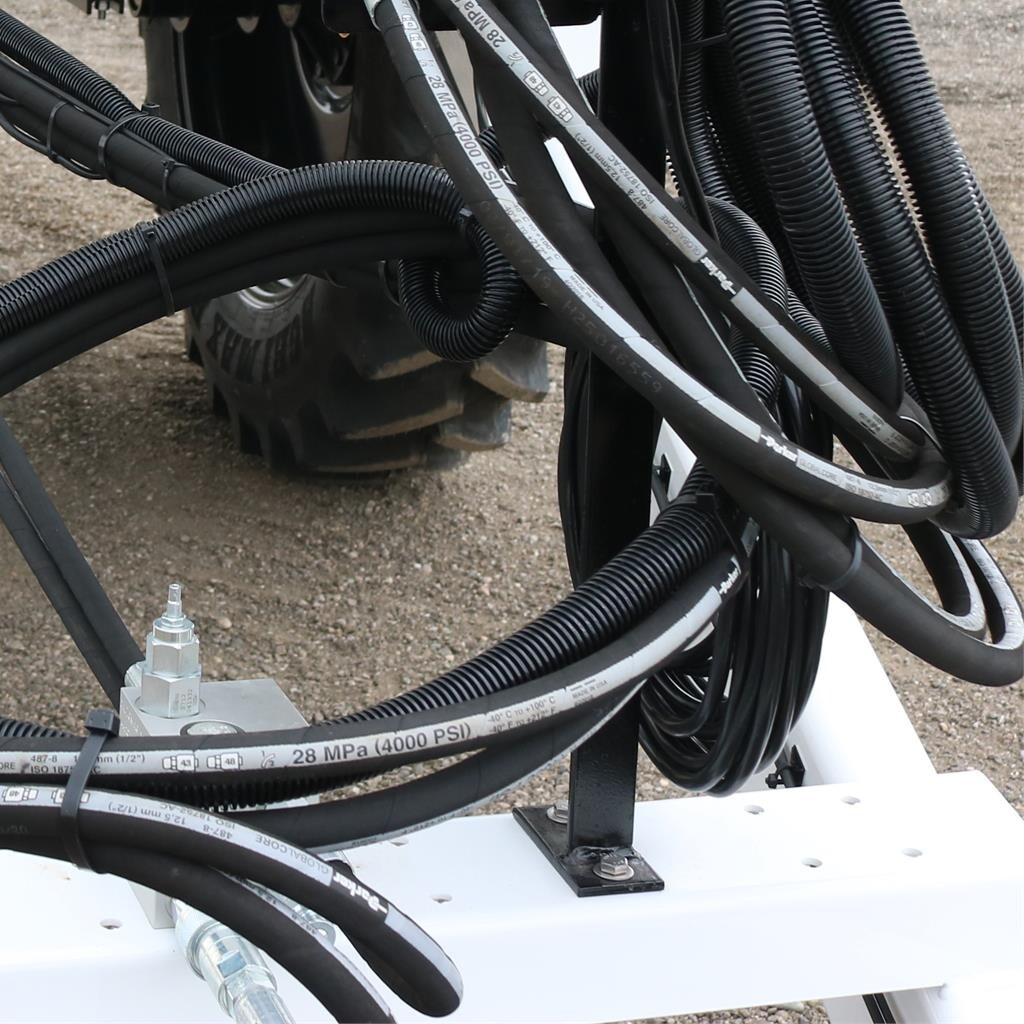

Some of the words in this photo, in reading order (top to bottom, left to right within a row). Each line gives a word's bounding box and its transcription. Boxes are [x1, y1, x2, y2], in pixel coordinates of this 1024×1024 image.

[464, 0, 490, 32] MPa
[487, 29, 506, 48] 28
[428, 75, 445, 89] 28
[436, 92, 458, 119] MPa
[453, 121, 482, 158] (4000
[476, 161, 504, 190] PSI)
[608, 154, 640, 188] 18752-AC
[640, 188, 655, 205] ISO
[700, 256, 733, 291] Parker
[766, 435, 797, 462] Parker
[506, 709, 513, 720] C
[548, 696, 555, 704] C
[507, 720, 515, 729] F
[292, 748, 317, 764] 28
[324, 743, 368, 762] MPa
[375, 733, 427, 756] (4000
[434, 722, 471, 745] PSI)
[30, 754, 58, 763] 487-8
[116, 755, 146, 764] (1/2")
[31, 765, 49, 774] ISO
[108, 802, 138, 815] (1/2")
[139, 808, 162, 818] mm
[164, 814, 186, 826] 12.5
[215, 818, 236, 830] ISO
[202, 825, 233, 840] 487-8
[256, 834, 329, 875] GLOBALCORE
[333, 872, 381, 912] Parker
